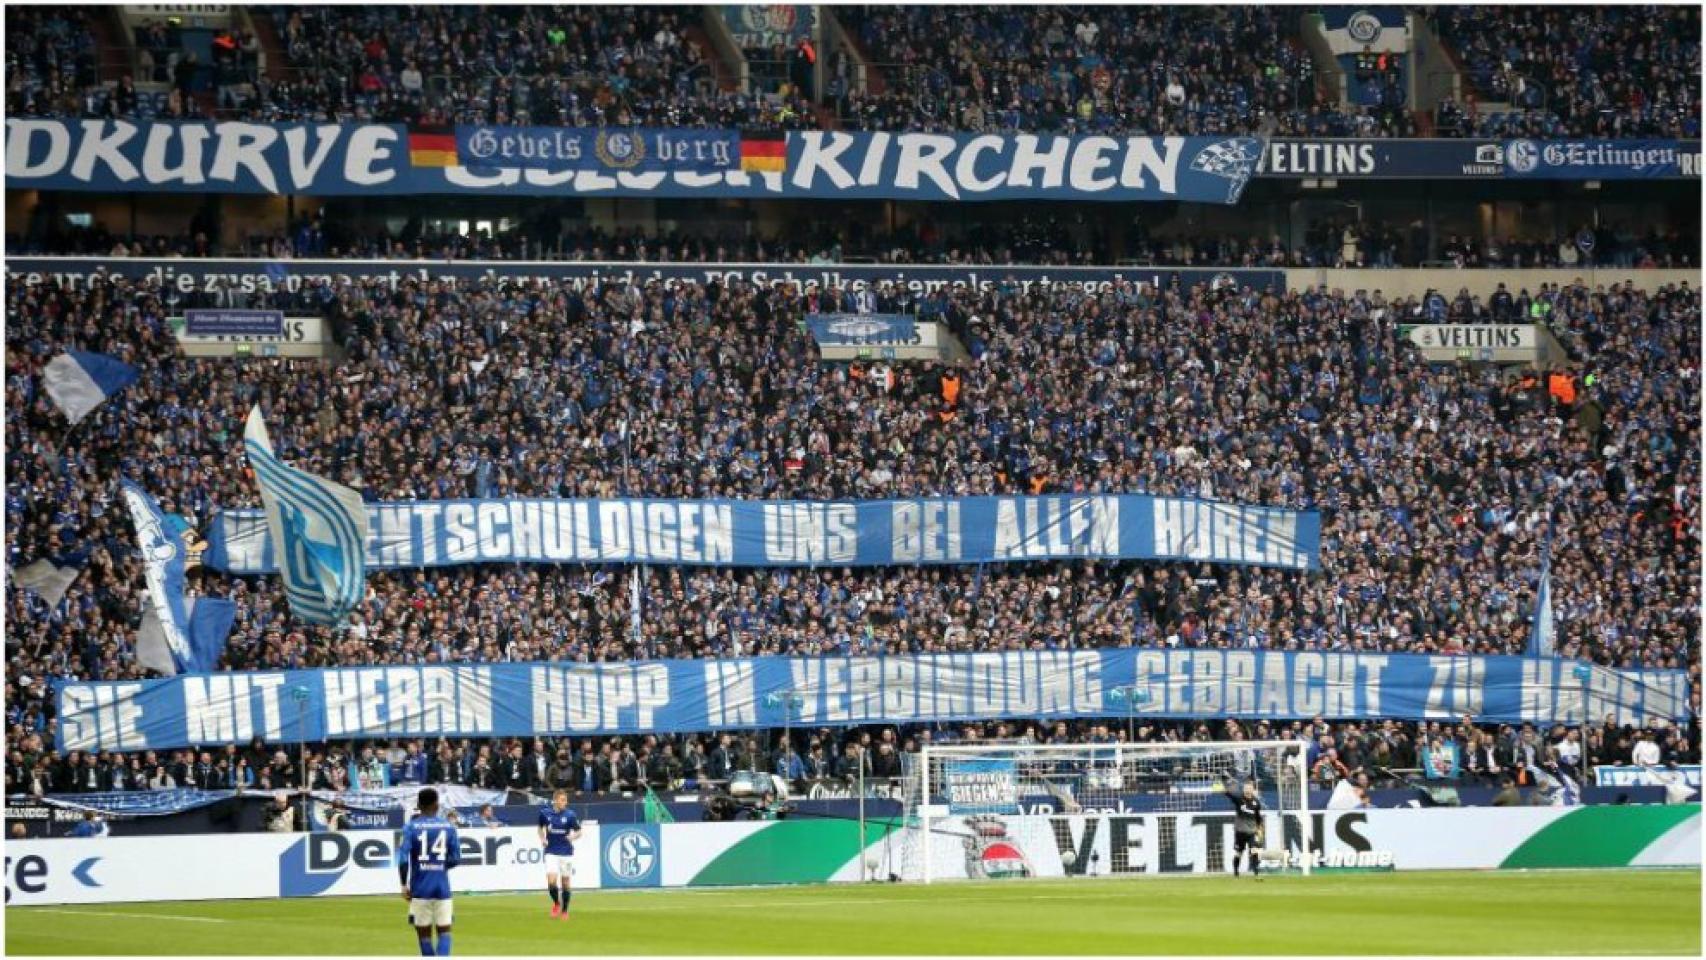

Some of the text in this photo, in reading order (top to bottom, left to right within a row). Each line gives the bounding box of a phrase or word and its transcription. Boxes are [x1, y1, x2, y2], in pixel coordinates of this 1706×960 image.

[5, 117, 398, 194] DKURVE
[656, 133, 731, 166] berg
[1438, 327, 1521, 347] VELTINS
[764, 503, 858, 562] UNS
[892, 501, 960, 559] BEI
[994, 498, 1118, 558] ALLEN
[61, 684, 147, 750] SIE
[183, 674, 285, 743] MIT
[323, 665, 493, 734] HERRN
[530, 663, 669, 733] HOPP
[704, 661, 756, 727] IN
[790, 650, 1103, 724] VERBINDUNG
[1135, 650, 1389, 716] GEBRACHT
[1424, 656, 1486, 719] ZU
[417, 830, 448, 861] 14
